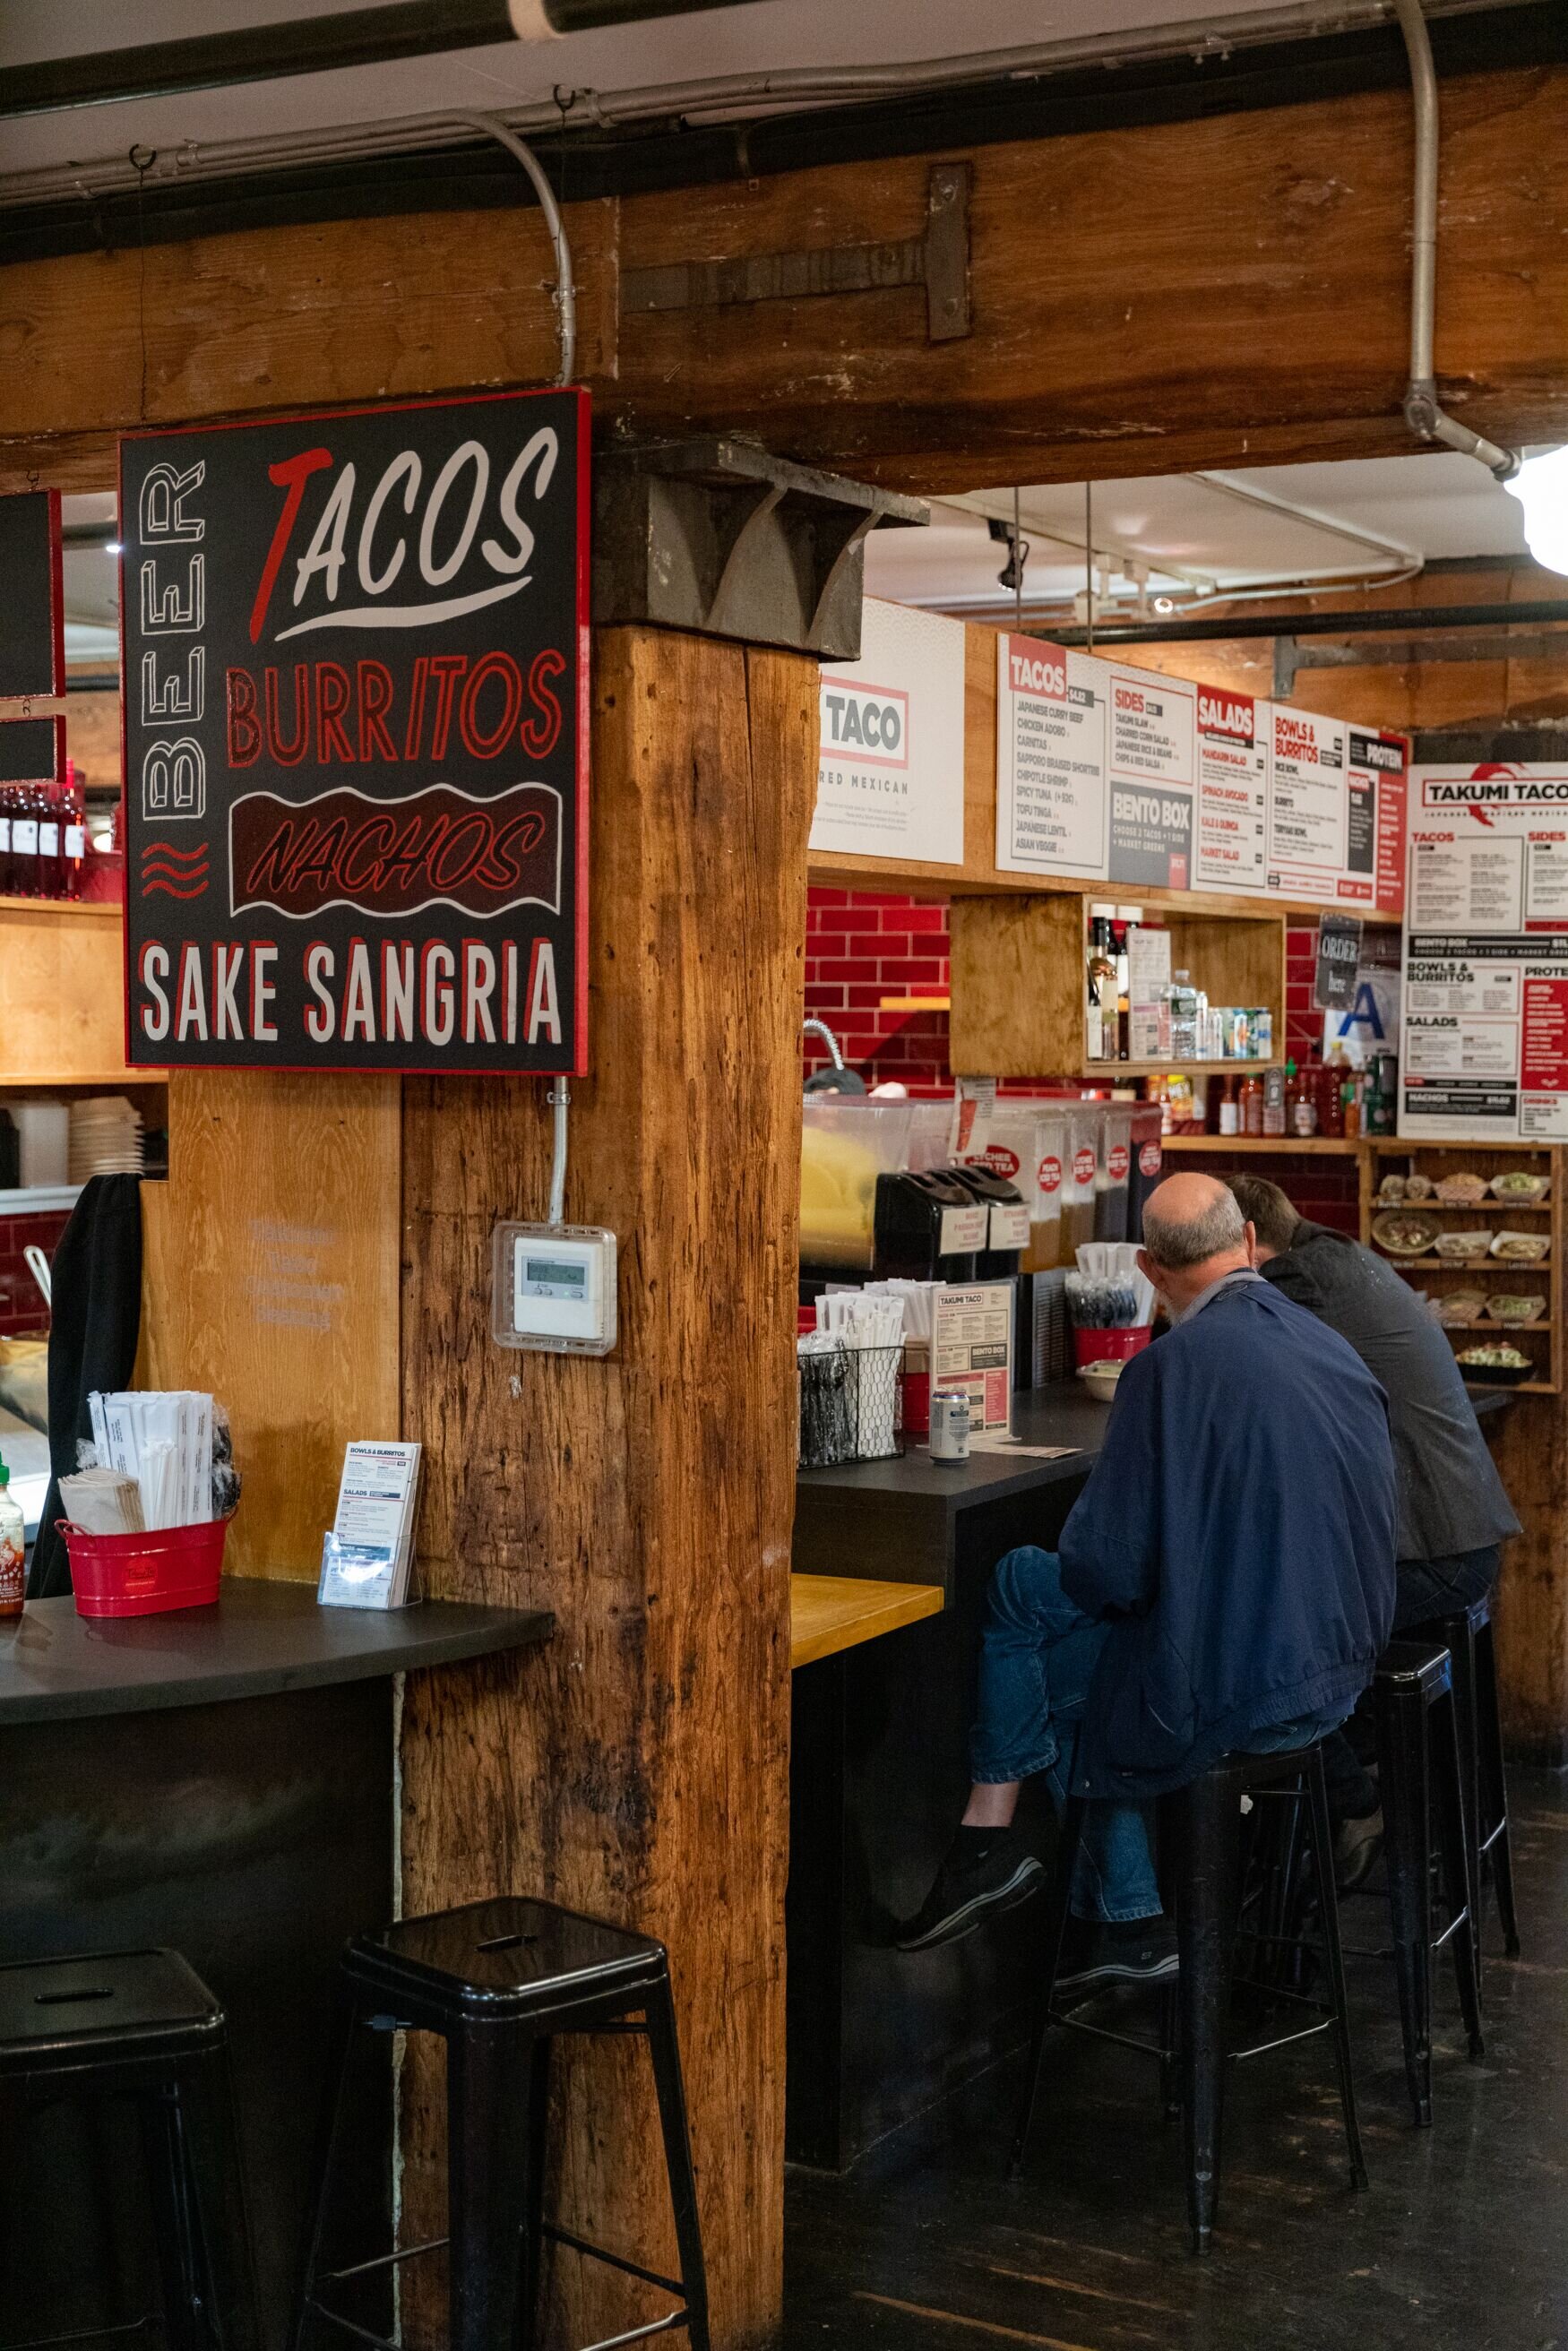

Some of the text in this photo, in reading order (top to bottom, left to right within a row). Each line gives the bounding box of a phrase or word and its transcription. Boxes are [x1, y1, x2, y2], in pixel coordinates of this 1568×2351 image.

[250, 426, 559, 644] TACOS
[139, 459, 206, 822] BEER
[1011, 654, 1065, 696] TACOS
[226, 648, 567, 769] BURRITOS
[1116, 688, 1144, 713] SIDES
[1017, 701, 1083, 724] JAPANESE CURRY BEEF
[1199, 696, 1253, 736] SALADS
[826, 694, 900, 751] TACO
[1017, 719, 1065, 737] CHICKEN ADOBO
[1275, 717, 1315, 743] BOWLS &
[1017, 736, 1047, 751] CARNITAS
[1116, 740, 1140, 753] JAPANESE
[1275, 737, 1319, 764] BURRITOS
[1017, 752, 1047, 768] SAPPORO
[1047, 757, 1072, 772] BRAISED
[1366, 743, 1402, 771] PROTEIN
[852, 775, 909, 795] MEXICAN
[1016, 769, 1068, 788] CHIPOTLE SHRIMP
[1016, 786, 1034, 798] SPICY
[1035, 788, 1052, 801] TUNA
[1429, 784, 1568, 801] TAKUMI TACO
[1016, 803, 1052, 819] TOFU TINGA
[1113, 792, 1160, 825] BENTO
[1162, 800, 1190, 830] BOX
[1016, 820, 1067, 837] JAPANESE LENTIL
[1113, 824, 1137, 839] CHOOSE
[1143, 829, 1161, 841] TACOS
[1412, 831, 1455, 843] TACOS
[1528, 831, 1566, 842] SIDES
[246, 810, 545, 894] NACHOS
[1016, 837, 1057, 853] ASIAN VEGGIE
[1117, 839, 1142, 850] MARKET
[1322, 935, 1358, 962] ORDER
[1415, 938, 1469, 948] BENTO BOX
[1408, 961, 1469, 972] BOWLS &
[1525, 966, 1568, 977] PROTE
[1328, 969, 1347, 993] here
[1408, 971, 1475, 982] BURRITOS
[139, 935, 562, 1046] SAKE SANGRIA
[1337, 981, 1385, 1039] A
[1407, 1017, 1458, 1027] SALADS
[995, 1163, 1014, 1172] TEA
[940, 1295, 982, 1305] TAKUMI TACO
[972, 1346, 1005, 1356] BENTO BOX
[350, 1447, 372, 1455] BOWLS
[343, 1488, 367, 1496] SALADS
